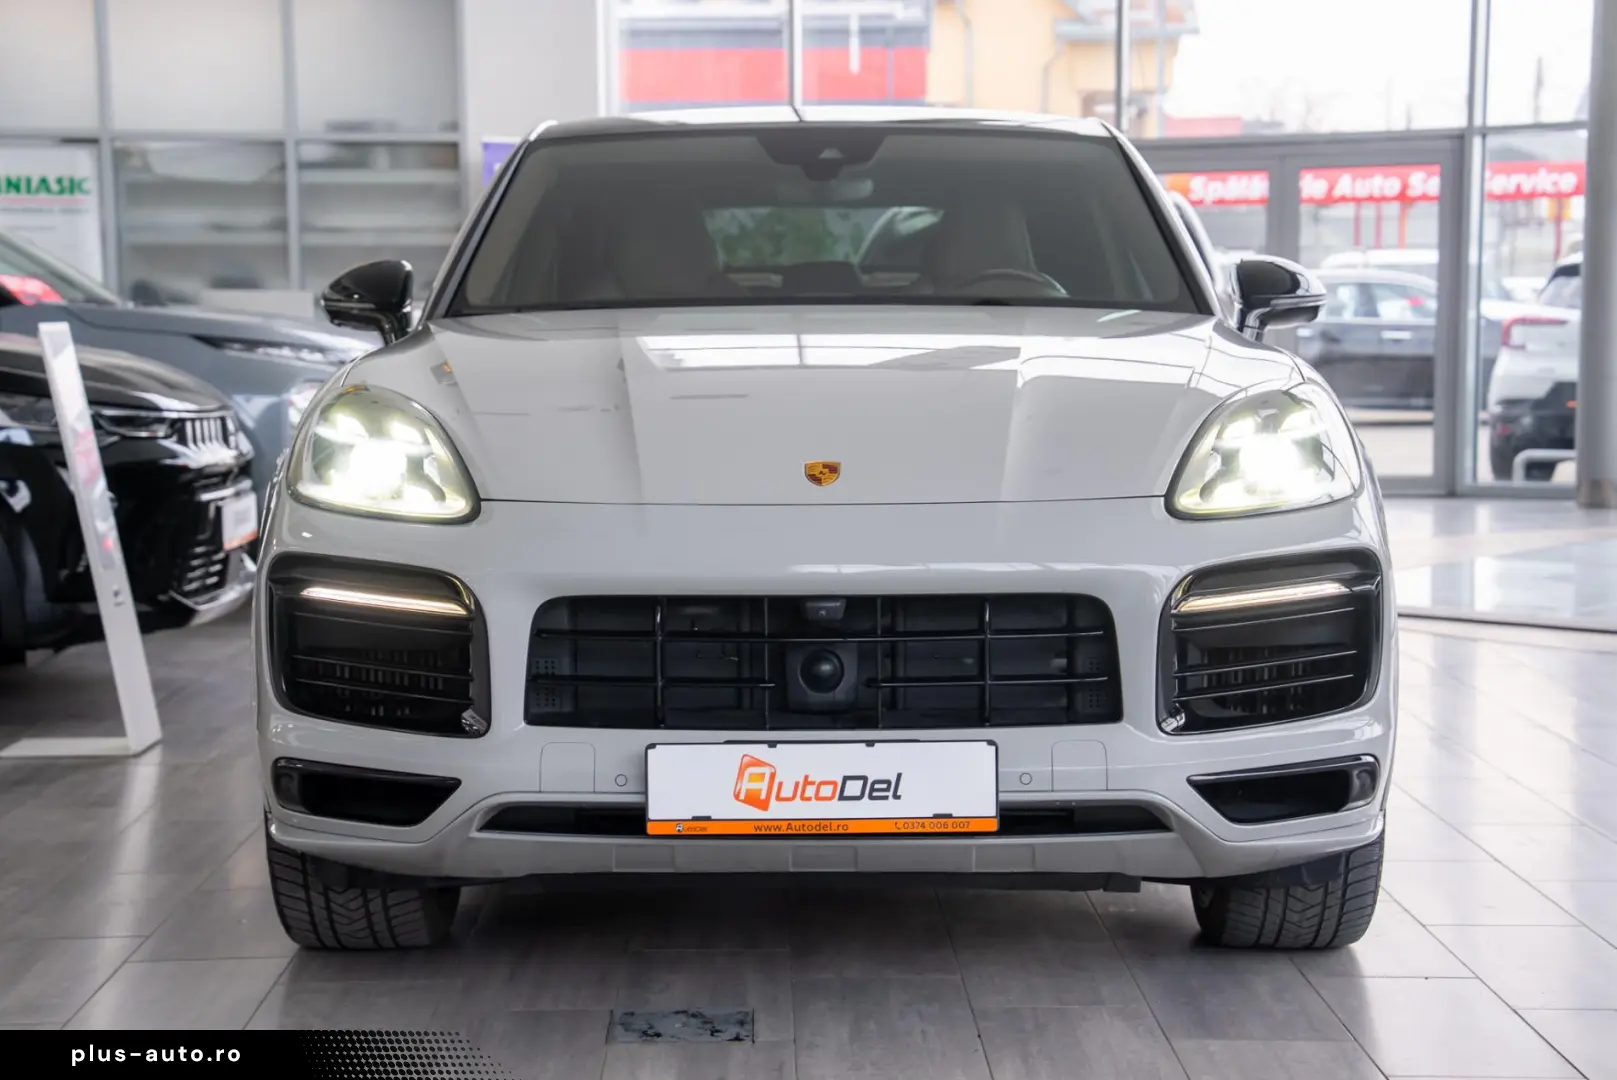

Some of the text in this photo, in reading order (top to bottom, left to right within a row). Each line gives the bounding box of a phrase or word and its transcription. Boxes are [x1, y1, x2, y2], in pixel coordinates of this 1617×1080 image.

[1331, 172, 1402, 199] Auto
[1405, 170, 1440, 197] Se
[736, 763, 903, 804] AutoDel
[753, 822, 849, 832] www.Autodel.ro
[951, 820, 971, 829] 007
